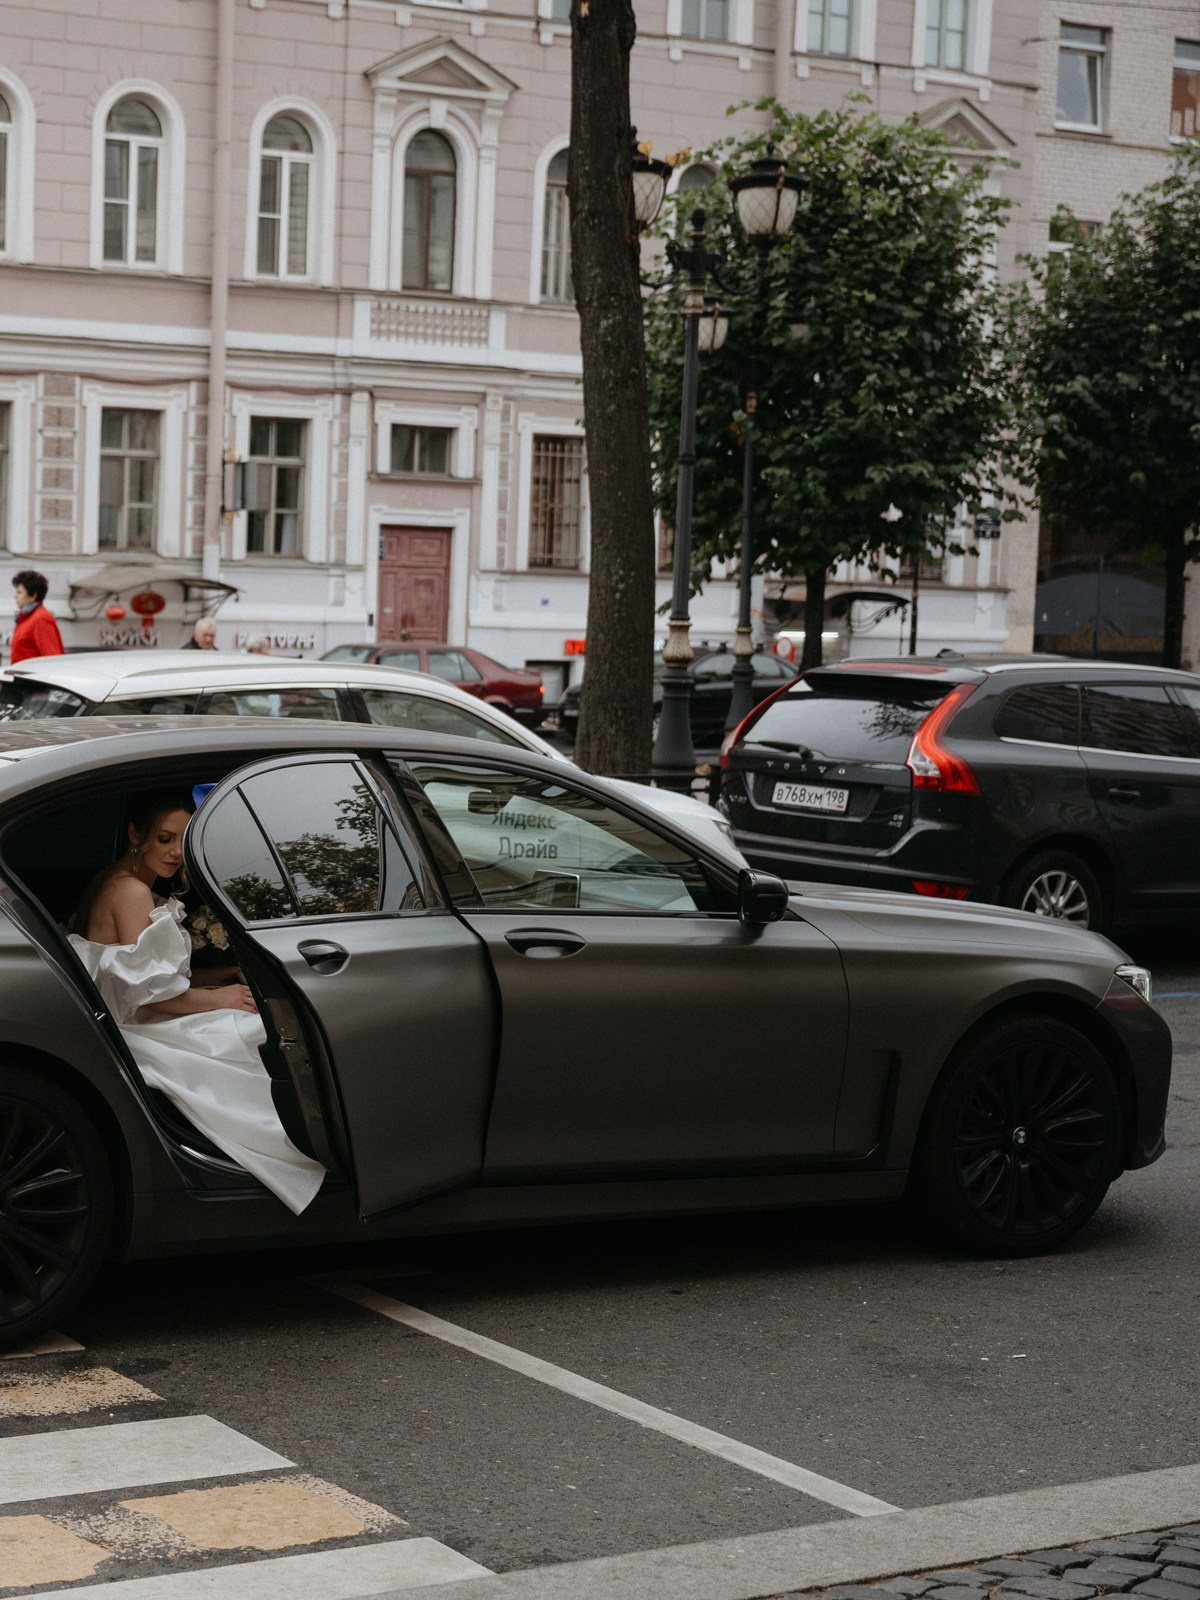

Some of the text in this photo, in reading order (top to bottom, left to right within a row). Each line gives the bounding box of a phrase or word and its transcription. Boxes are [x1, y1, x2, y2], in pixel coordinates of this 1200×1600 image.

[234, 631, 315, 649] РТОРАН
[826, 790, 845, 803] 198
[498, 836, 558, 859] Драйв
